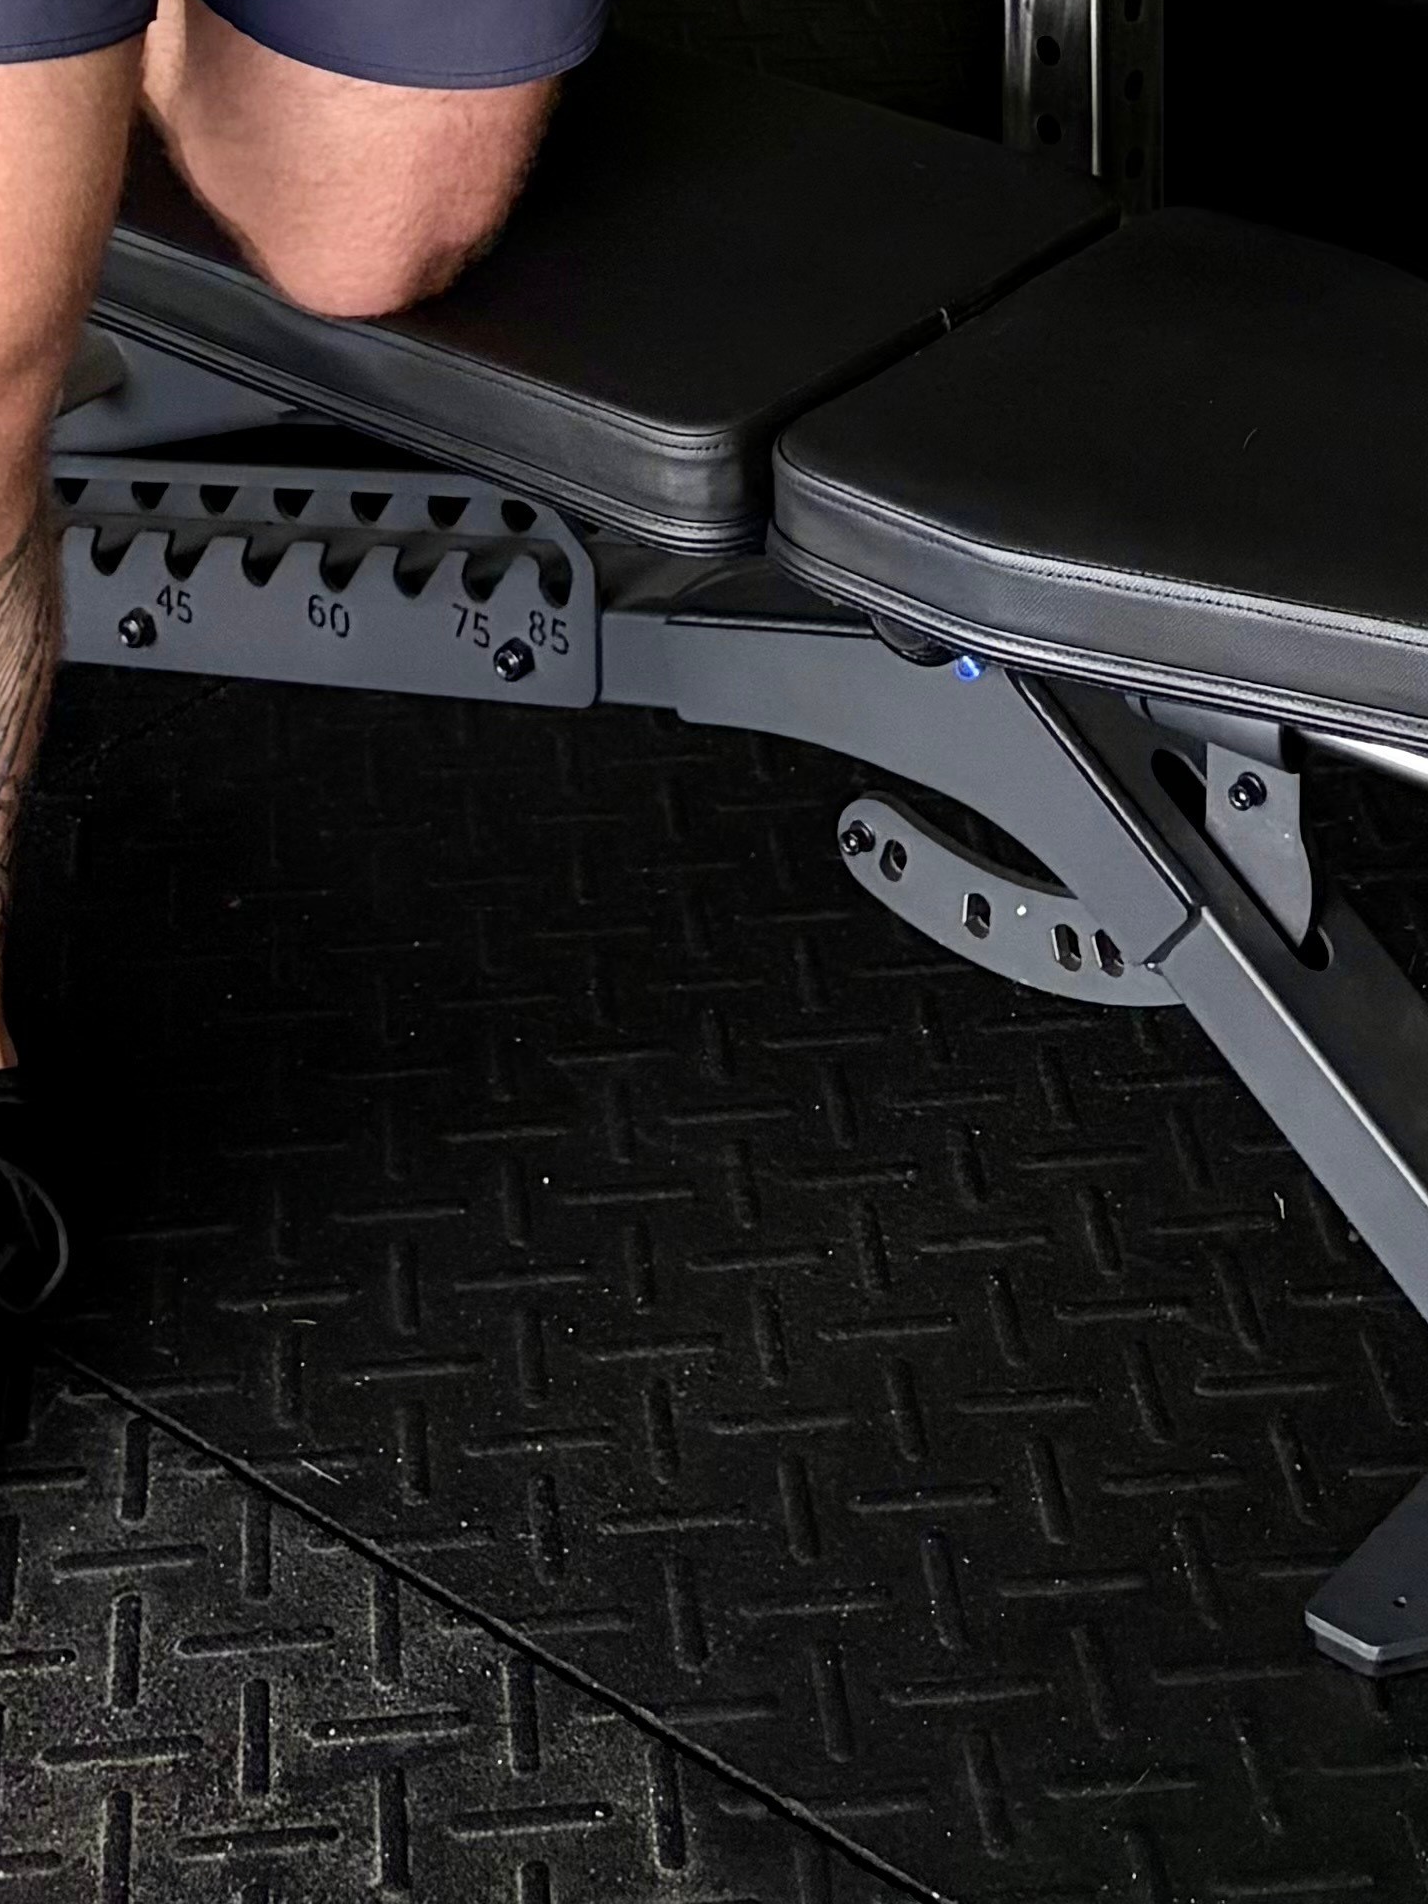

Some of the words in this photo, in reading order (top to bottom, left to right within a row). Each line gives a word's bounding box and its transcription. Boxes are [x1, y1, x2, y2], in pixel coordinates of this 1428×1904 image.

[156, 585, 193, 624] 45
[308, 594, 350, 638] 60
[451, 603, 490, 648] 75
[529, 610, 569, 655] 85
